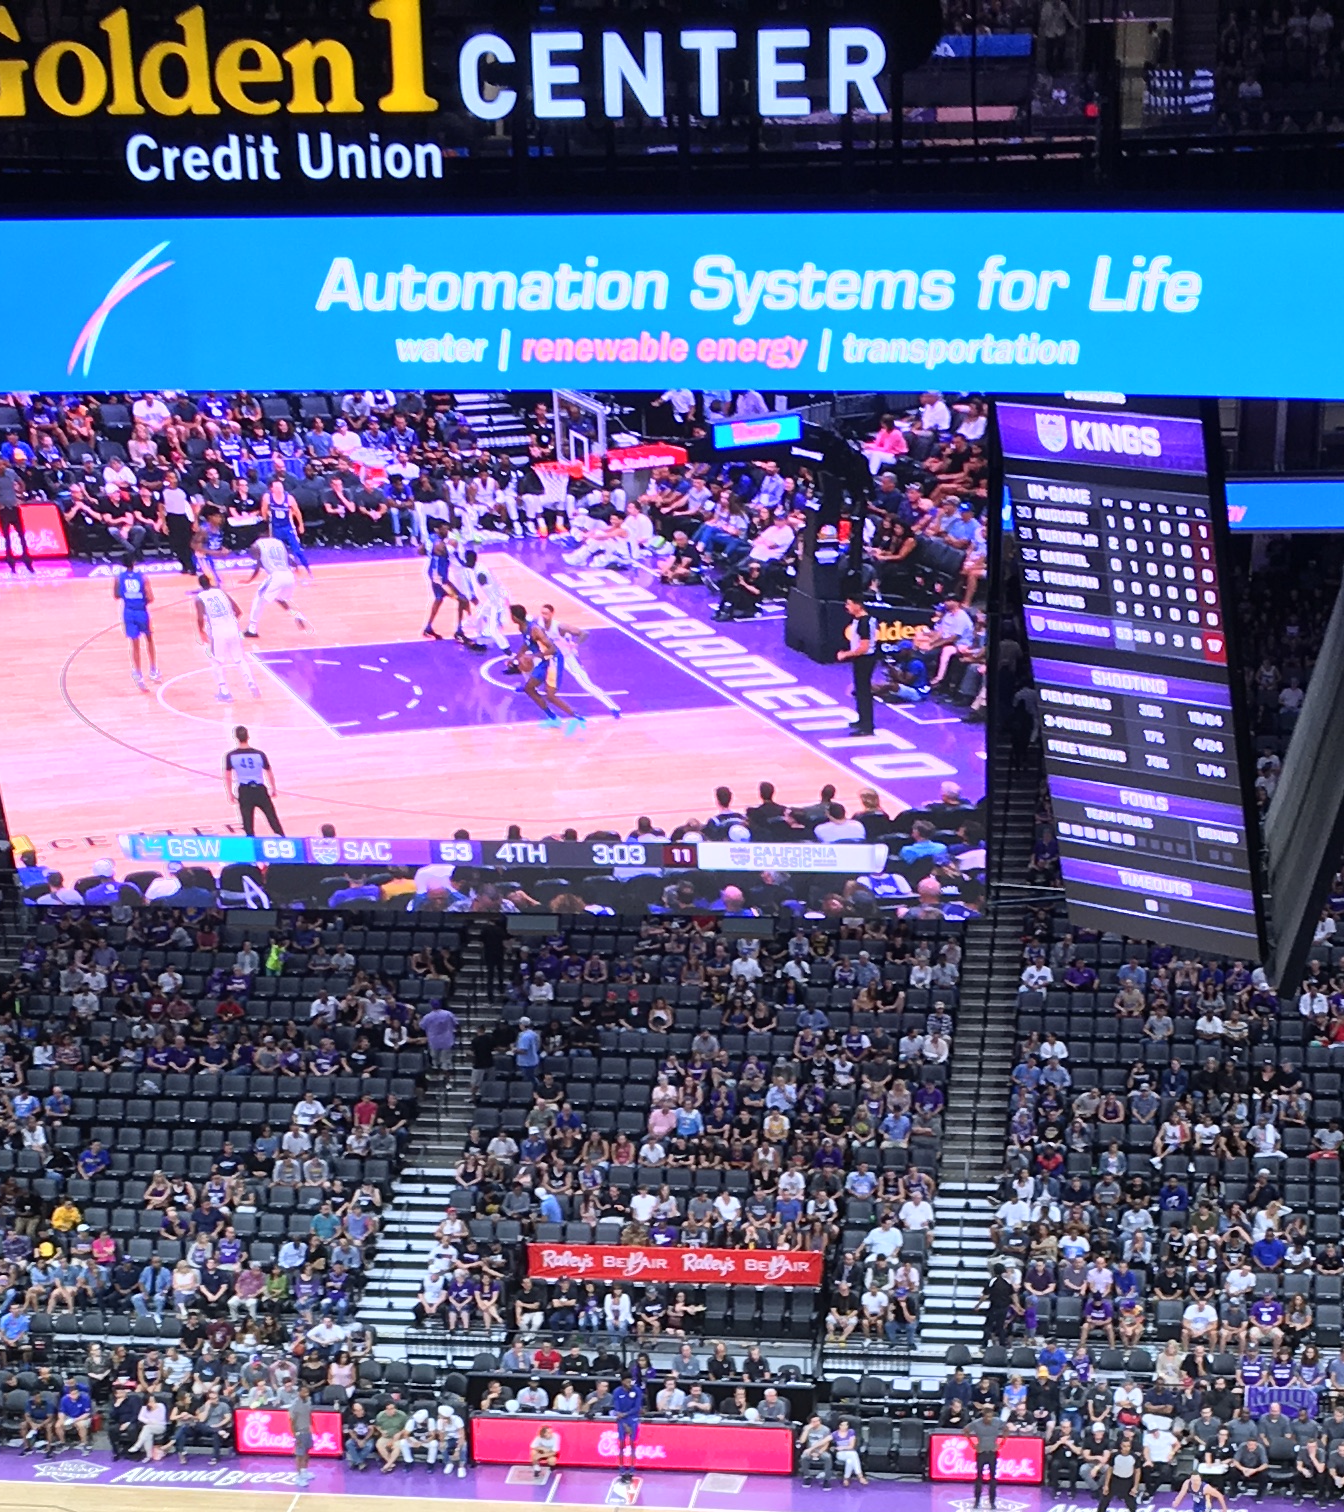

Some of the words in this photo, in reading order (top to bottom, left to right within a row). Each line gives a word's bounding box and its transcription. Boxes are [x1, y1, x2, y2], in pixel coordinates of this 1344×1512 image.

[459, 27, 887, 120] CENTER
[126, 131, 281, 183] Credit
[297, 132, 444, 181] Union
[317, 255, 668, 312] Automation
[690, 256, 954, 323] Systems
[978, 255, 1069, 312] for
[1089, 255, 1203, 312] Life
[396, 335, 489, 363] water
[522, 331, 688, 363] renewable
[696, 335, 809, 370] energy
[842, 331, 1080, 369] transportation
[1071, 420, 1162, 457] KINGS
[1027, 483, 1092, 506] IN-GAME
[1019, 526, 1033, 540] 31
[1039, 549, 1091, 568] GABRIEL
[1042, 569, 1100, 590] FREEMAN
[1045, 591, 1086, 609] HAYES
[1115, 626, 1134, 641] 53
[552, 569, 958, 779] SACRAMENTO
[1091, 669, 1168, 695] SHOOTING
[1119, 789, 1169, 812] FOULS
[168, 838, 221, 858] GSW
[263, 841, 294, 858] 69
[343, 841, 393, 861] SAC
[440, 842, 473, 861] 53
[496, 844, 547, 864] 4TH
[592, 844, 646, 865] 3:03
[671, 848, 691, 863] 11
[753, 846, 837, 858] CALIFORNIA
[753, 856, 812, 868] CLASSIC
[1118, 870, 1194, 897] TIMEOUTS
[541, 1250, 594, 1274] Raley's
[681, 1253, 735, 1277] Raley's
[111, 1467, 221, 1483] Almond
[214, 1468, 302, 1486] Breez
